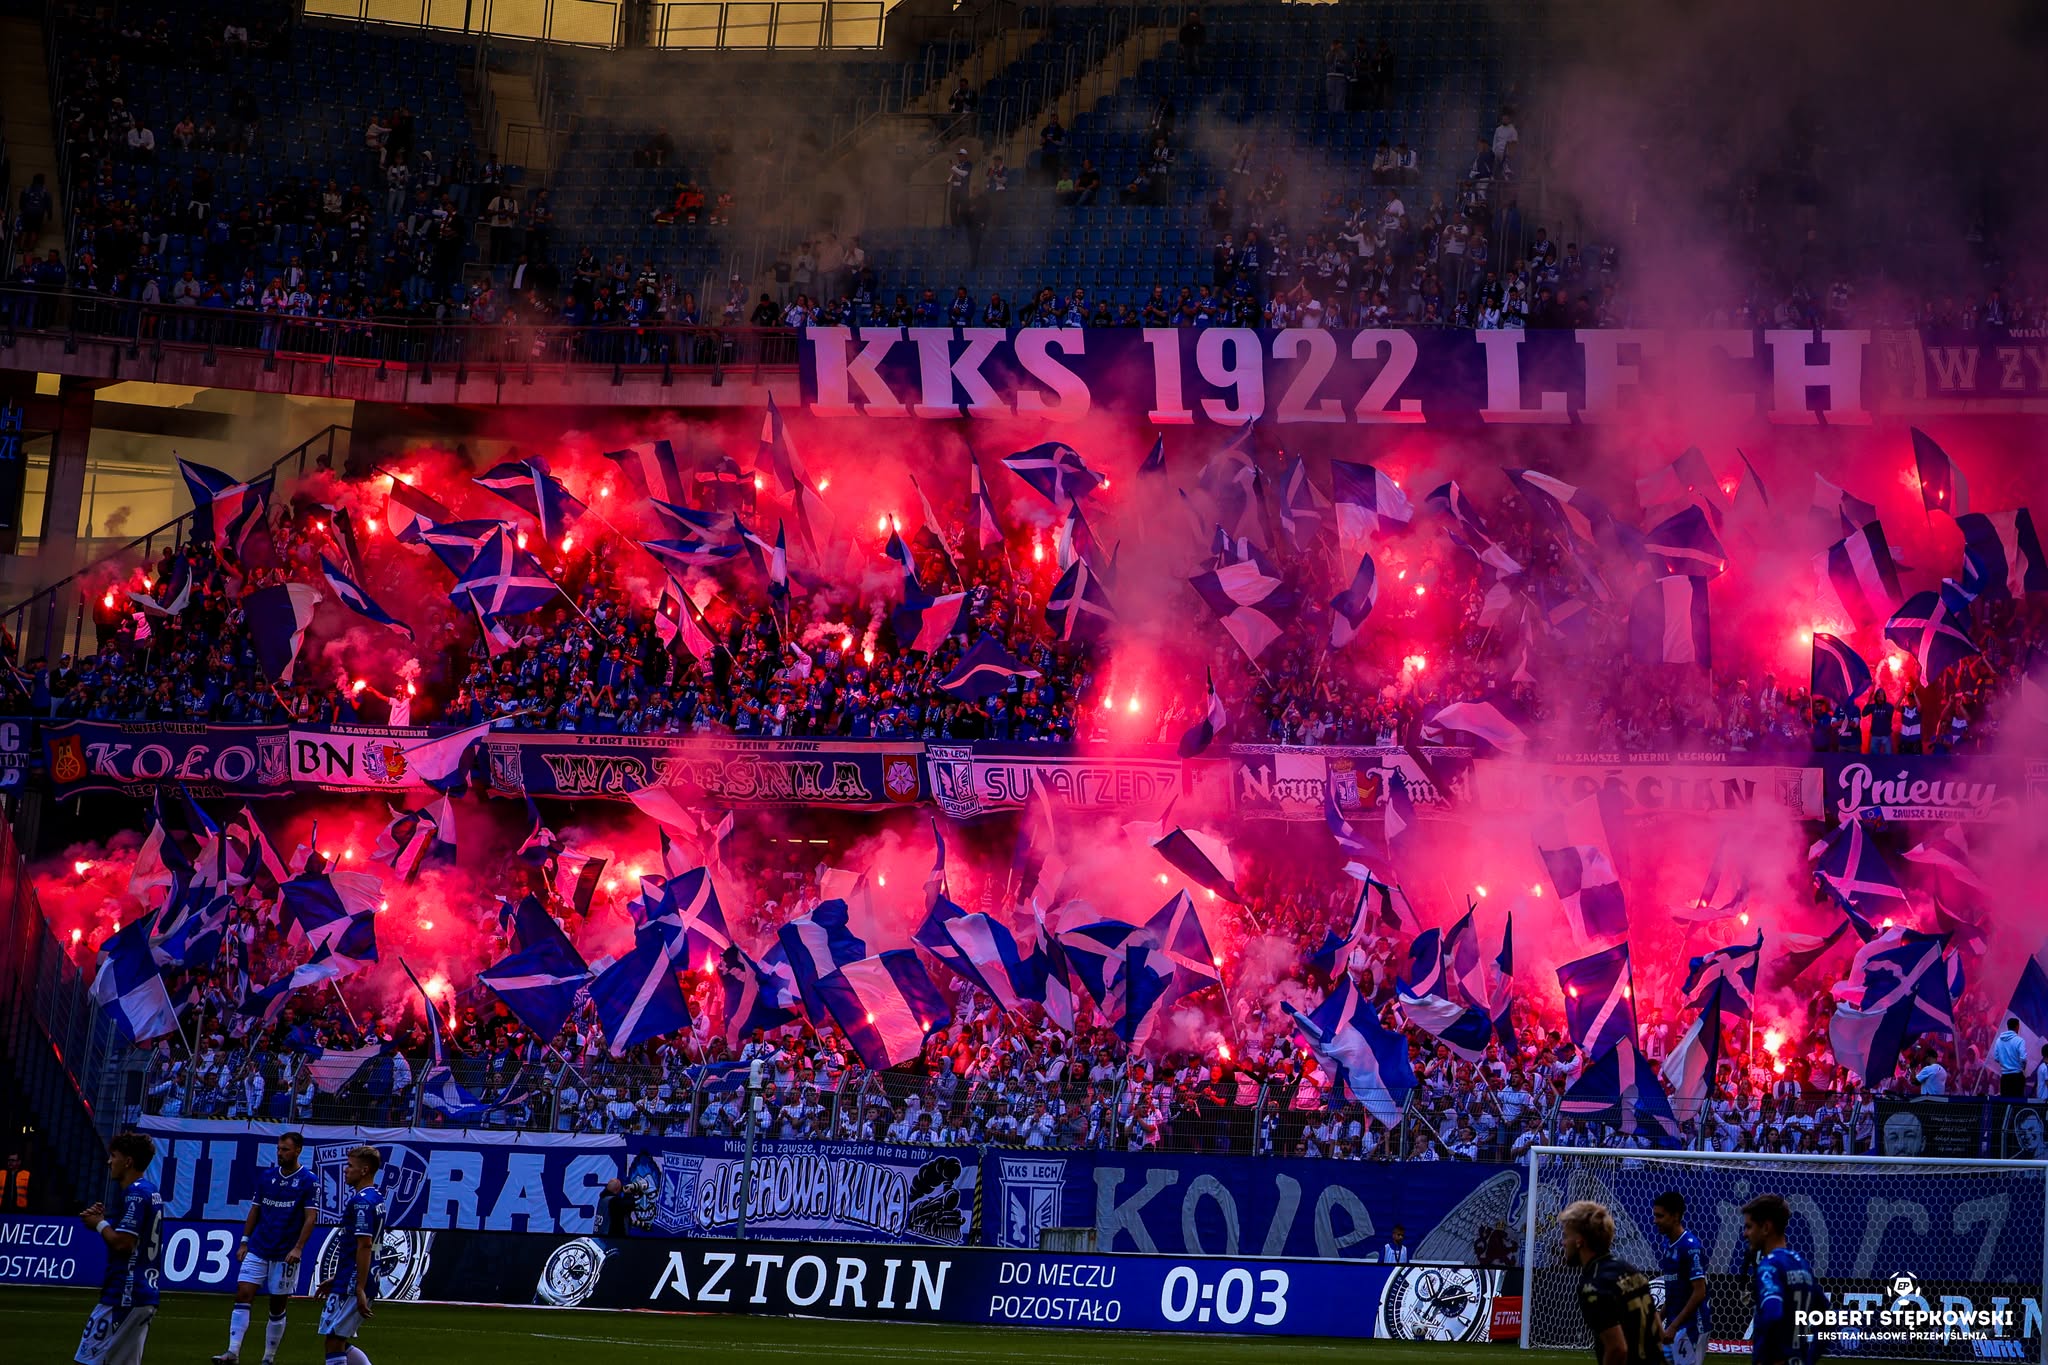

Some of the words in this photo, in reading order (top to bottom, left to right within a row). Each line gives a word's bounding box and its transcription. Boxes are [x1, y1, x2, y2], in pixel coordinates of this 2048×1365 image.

[806, 327, 1091, 423] KKS
[1144, 327, 1425, 426] 1922
[1476, 328, 1873, 426] LECH
[1927, 345, 1980, 392] W
[163, 722, 207, 735] WIERNI
[330, 725, 346, 734] NA
[346, 726, 389, 736] ZAWSZE
[389, 728, 428, 738] WIERNI
[575, 736, 584, 745] Z
[588, 736, 623, 745] KART
[628, 737, 685, 747] HISTORII
[775, 741, 821, 752] ZNANE
[85, 742, 256, 783] KOŁO
[295, 739, 355, 779] BN
[934, 749, 948, 758] KKS
[951, 751, 970, 760] LECH
[1574, 753, 1620, 763] ZAWSZE
[1628, 753, 1671, 763] WIERNI
[1677, 752, 1728, 763] LECHOWI
[541, 754, 872, 801] WRZEŚNIA
[1892, 809, 1925, 819] ZAWSZE
[1927, 809, 1934, 818] Z
[322, 1149, 338, 1160] KKS
[724, 1139, 758, 1154] Miłoć
[761, 1143, 774, 1154] na
[820, 1143, 874, 1158] przyjaźnie
[877, 1146, 893, 1157] nie
[895, 1149, 908, 1159] na
[666, 1155, 680, 1166] KKS
[682, 1158, 700, 1168] LECH
[1007, 1164, 1029, 1178] KKS
[1032, 1165, 1058, 1179] LECH
[262, 1196, 297, 1208] SUPERBET
[832, 1157, 909, 1237] KLIKA
[281, 1263, 294, 1278] 16
[999, 1261, 1029, 1285] DO
[1037, 1262, 1117, 1289] MECZU
[650, 1250, 953, 1311] AZTORIN
[1161, 1265, 1289, 1325] 0:03
[989, 1294, 1122, 1323] POZOSTAŁO
[83, 1317, 109, 1341] 99
[1678, 1339, 1688, 1358] 4
[1707, 1342, 1754, 1353] SUPE
